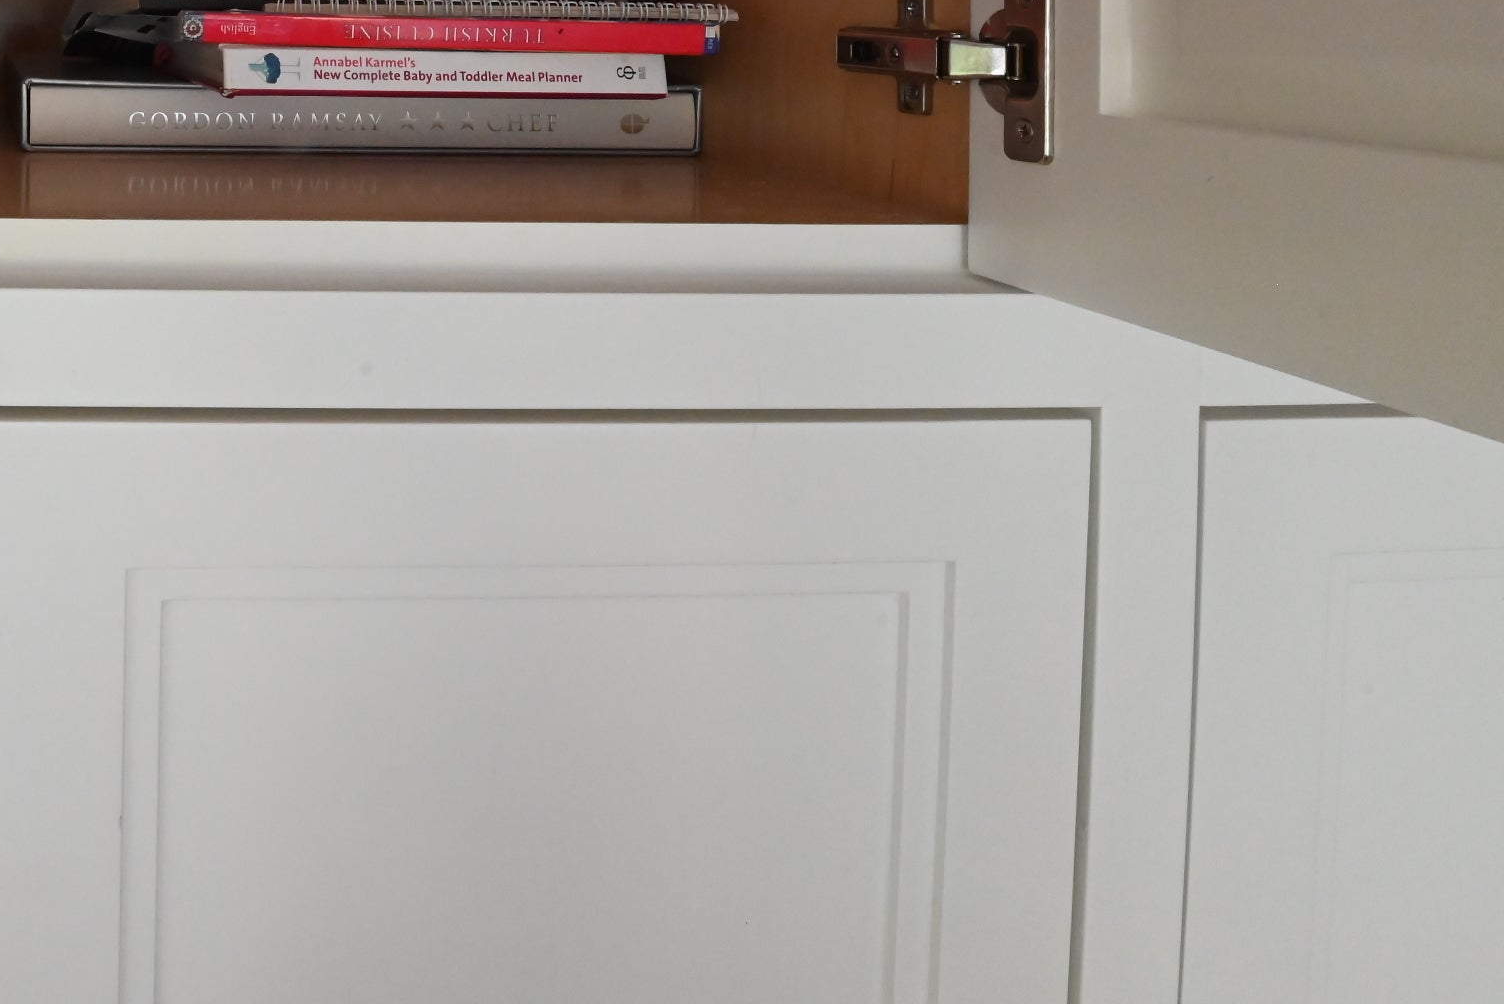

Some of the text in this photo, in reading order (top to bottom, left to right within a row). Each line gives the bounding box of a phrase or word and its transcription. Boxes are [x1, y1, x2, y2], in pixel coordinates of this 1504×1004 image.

[220, 23, 256, 36] English
[313, 56, 416, 68] Annabel Karmel's
[313, 70, 583, 84] New Complete Baby and Toddler Meal Planner
[129, 111, 382, 131] GORDON RAMSAY
[486, 113, 558, 132] CHEF
